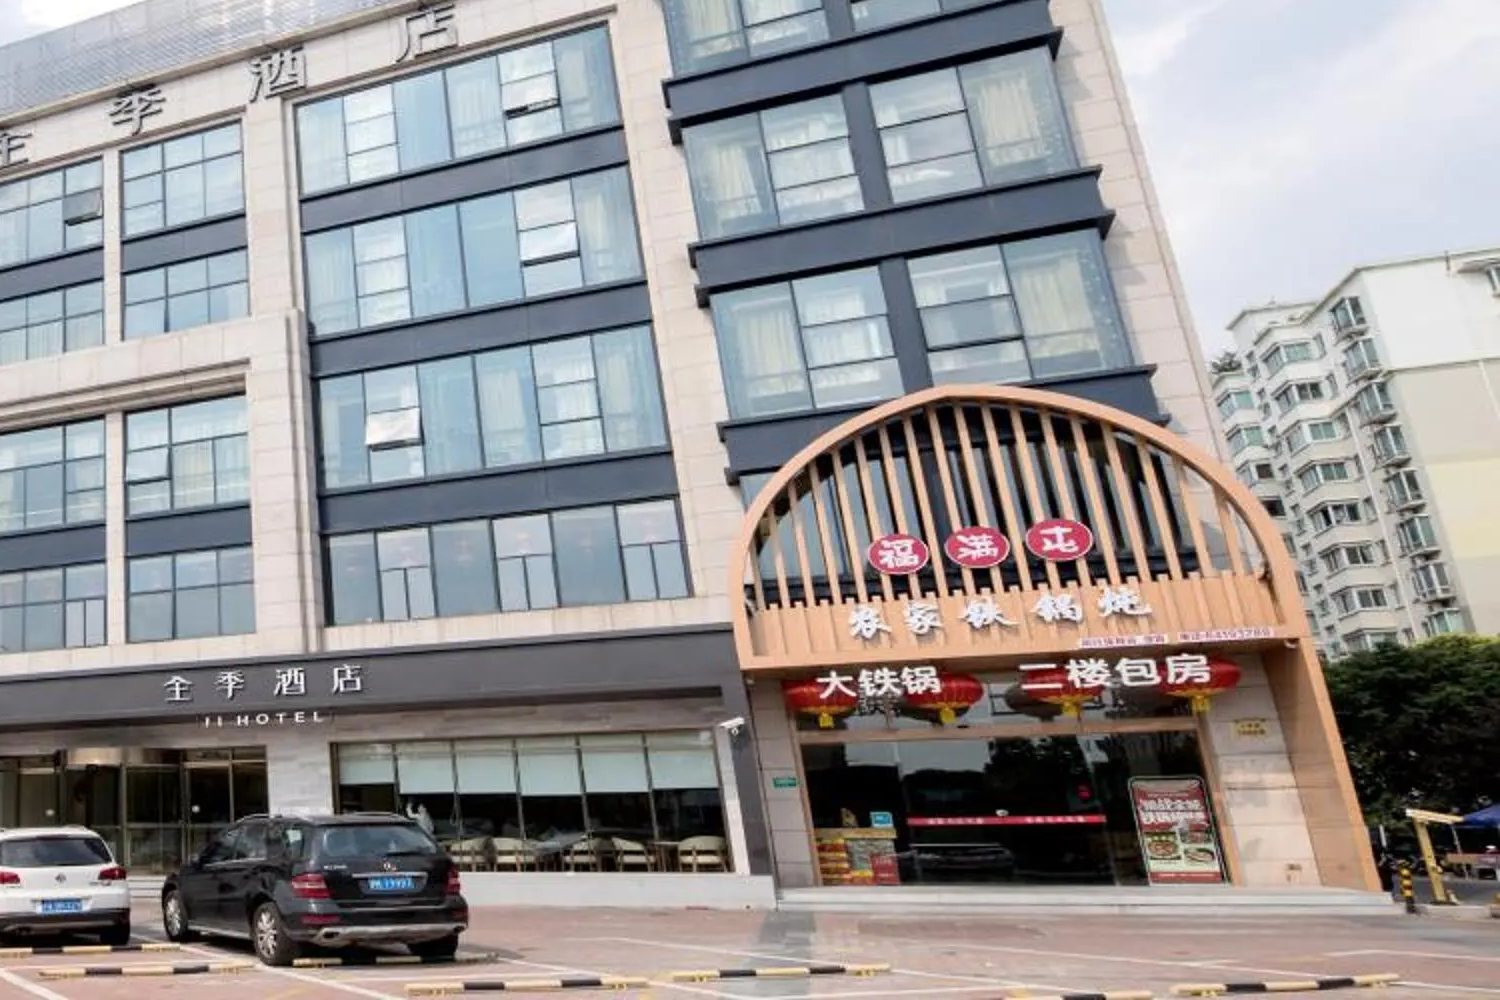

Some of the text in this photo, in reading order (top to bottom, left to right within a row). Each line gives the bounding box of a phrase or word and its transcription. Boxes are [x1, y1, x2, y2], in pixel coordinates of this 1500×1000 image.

[877, 525, 1079, 569] 福满屯
[163, 664, 363, 702] 全季酒店
[816, 665, 943, 699] 大铁锅
[1018, 653, 1212, 690] 二楼包房
[236, 711, 325, 727] HOTEL
